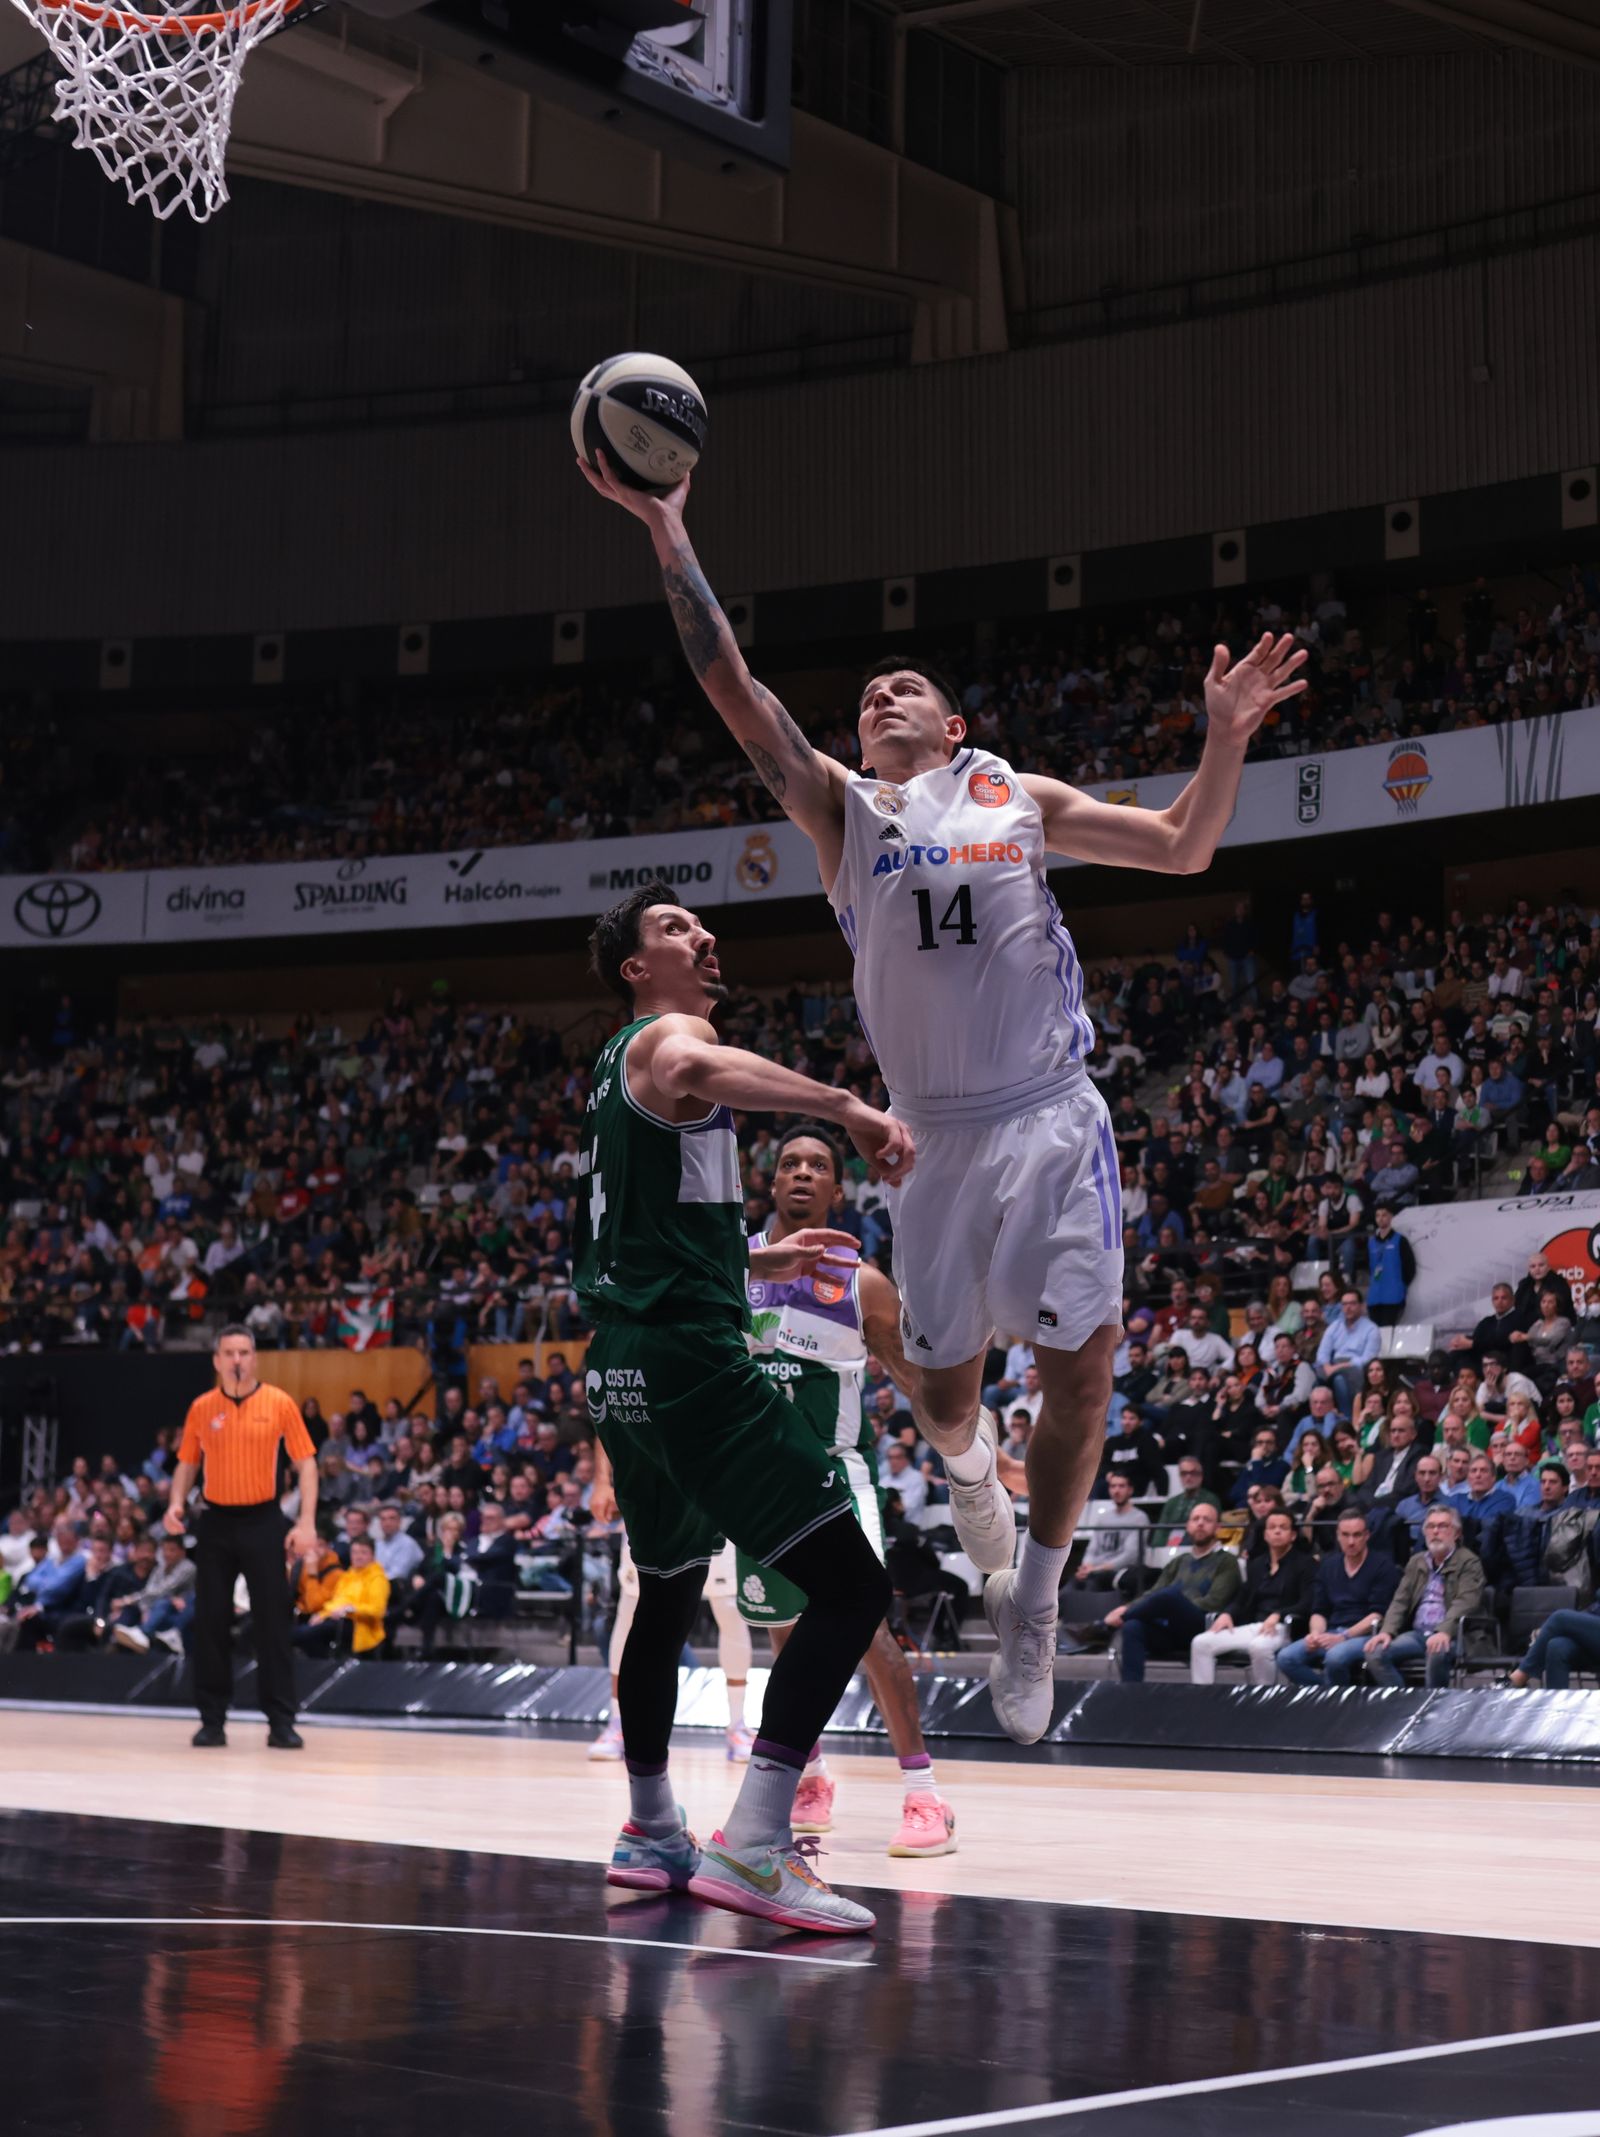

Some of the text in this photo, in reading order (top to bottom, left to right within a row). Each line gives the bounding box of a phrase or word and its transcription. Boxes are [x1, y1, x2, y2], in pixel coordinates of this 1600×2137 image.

[641, 387, 706, 446] SPALD
[873, 842, 1023, 876] AUTOHERO
[609, 861, 712, 891] MONDO
[166, 885, 246, 912] divina
[293, 876, 407, 912] SPALDING
[444, 880, 522, 904] Halcón
[911, 884, 978, 951] 14
[1497, 1194, 1576, 1212] COPA
[778, 1328, 818, 1351] nicaja
[604, 1367, 647, 1388] COSTA
[605, 1390, 649, 1407] DEL SOL
